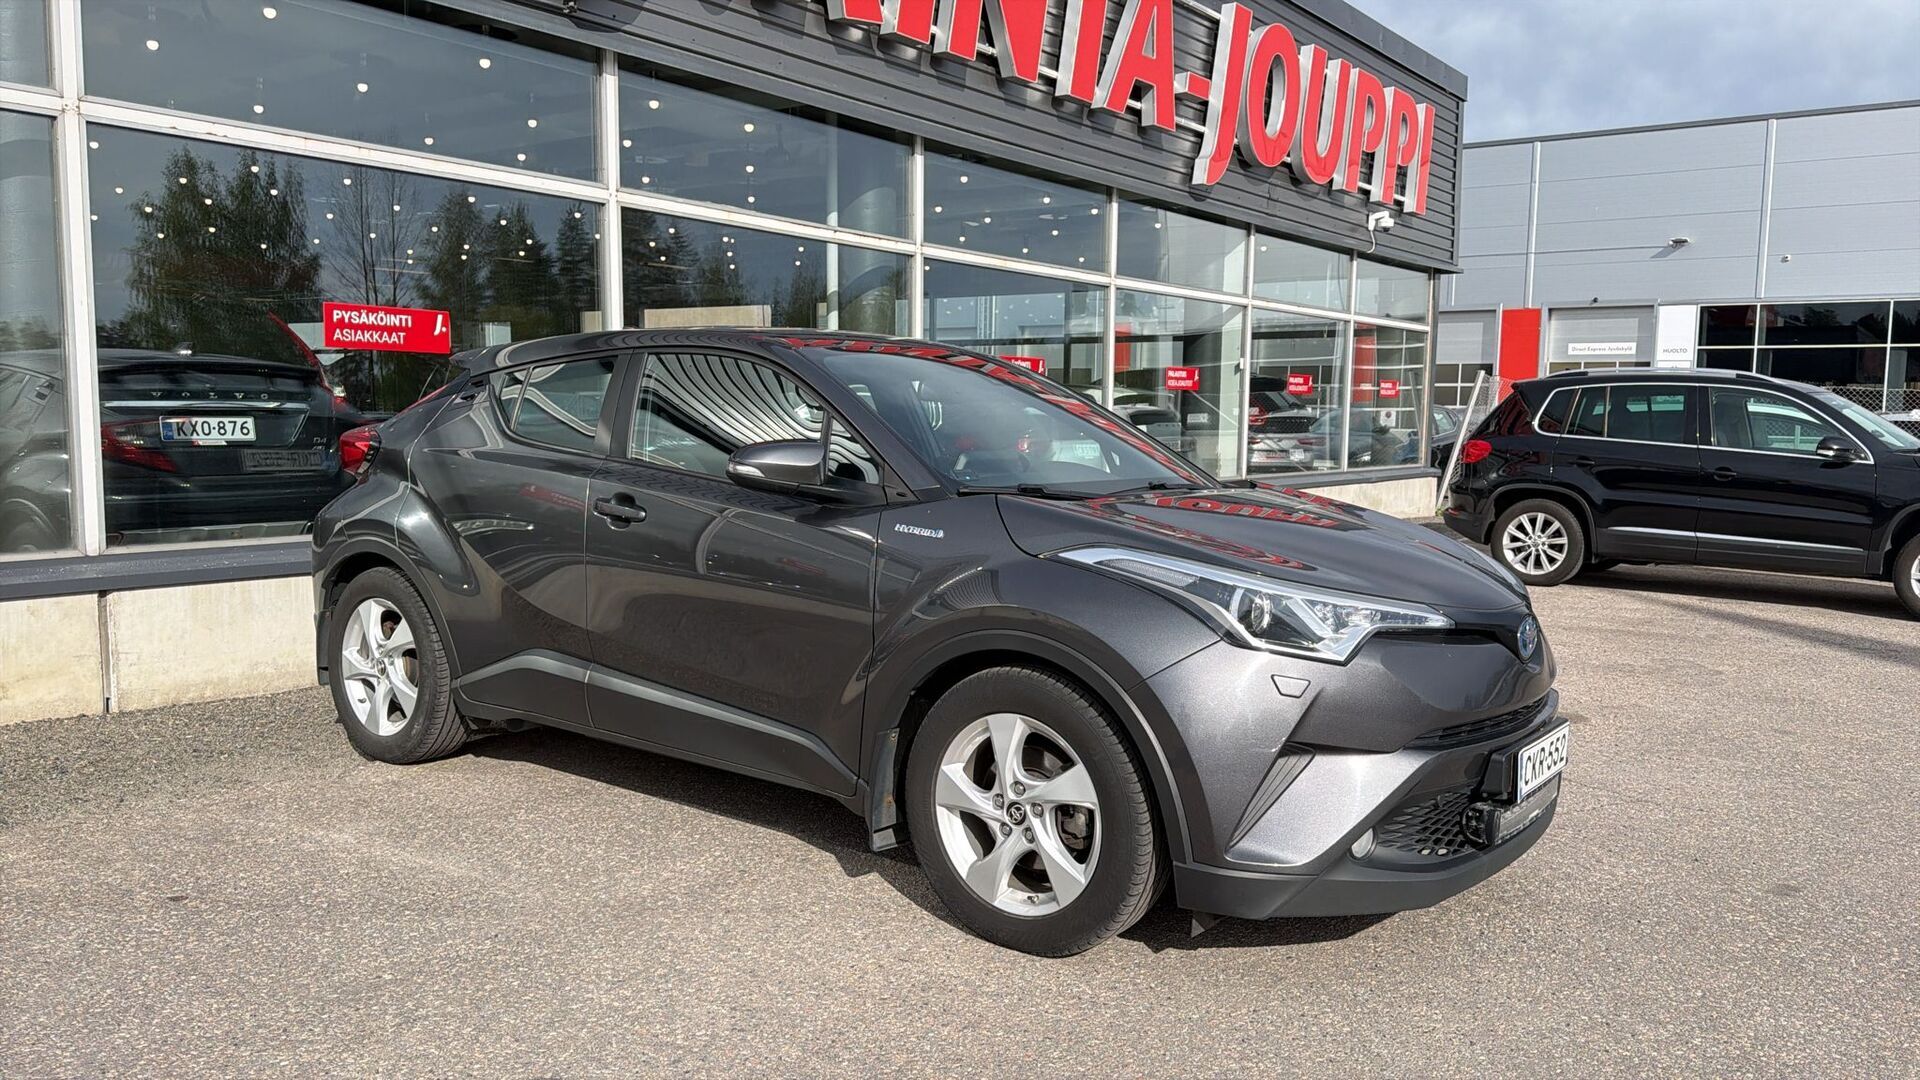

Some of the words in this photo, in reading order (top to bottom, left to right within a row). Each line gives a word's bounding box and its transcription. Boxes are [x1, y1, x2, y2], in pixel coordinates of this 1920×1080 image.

[827, 0, 1435, 217] NA-JOUPPI
[333, 309, 412, 328] PYSÄKÖINTI
[333, 328, 406, 344] ASIAKKAAT
[151, 391, 269, 400] VOLVO
[894, 523, 943, 538] HYBRID
[1524, 733, 1567, 786] CKR-552
